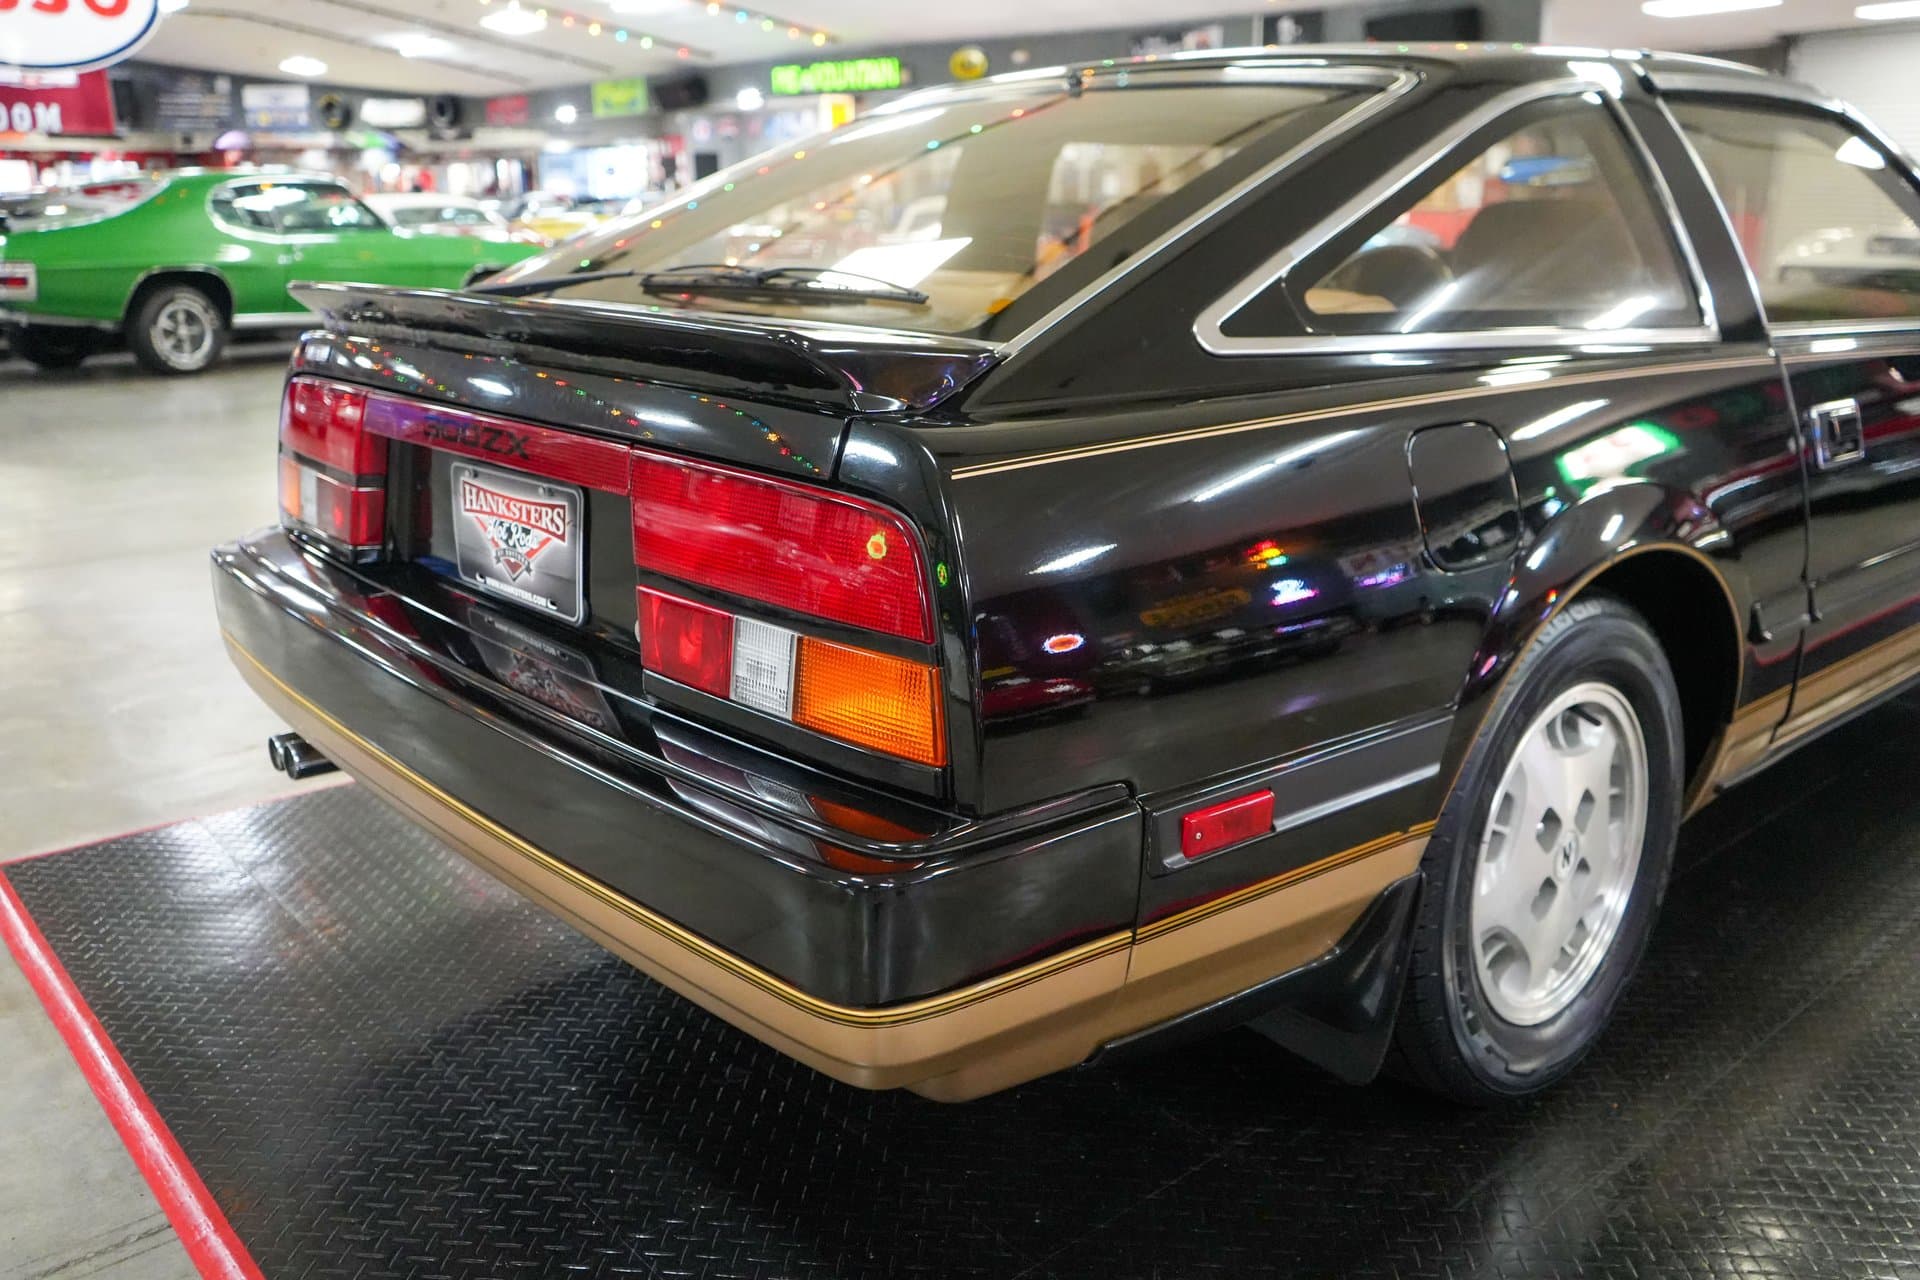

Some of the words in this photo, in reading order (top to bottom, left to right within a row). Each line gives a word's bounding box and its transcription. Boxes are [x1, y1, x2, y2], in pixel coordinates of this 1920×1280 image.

[464, 484, 566, 535] HANKSTERS
[487, 518, 508, 541] Hot
[509, 521, 539, 550] Rods
